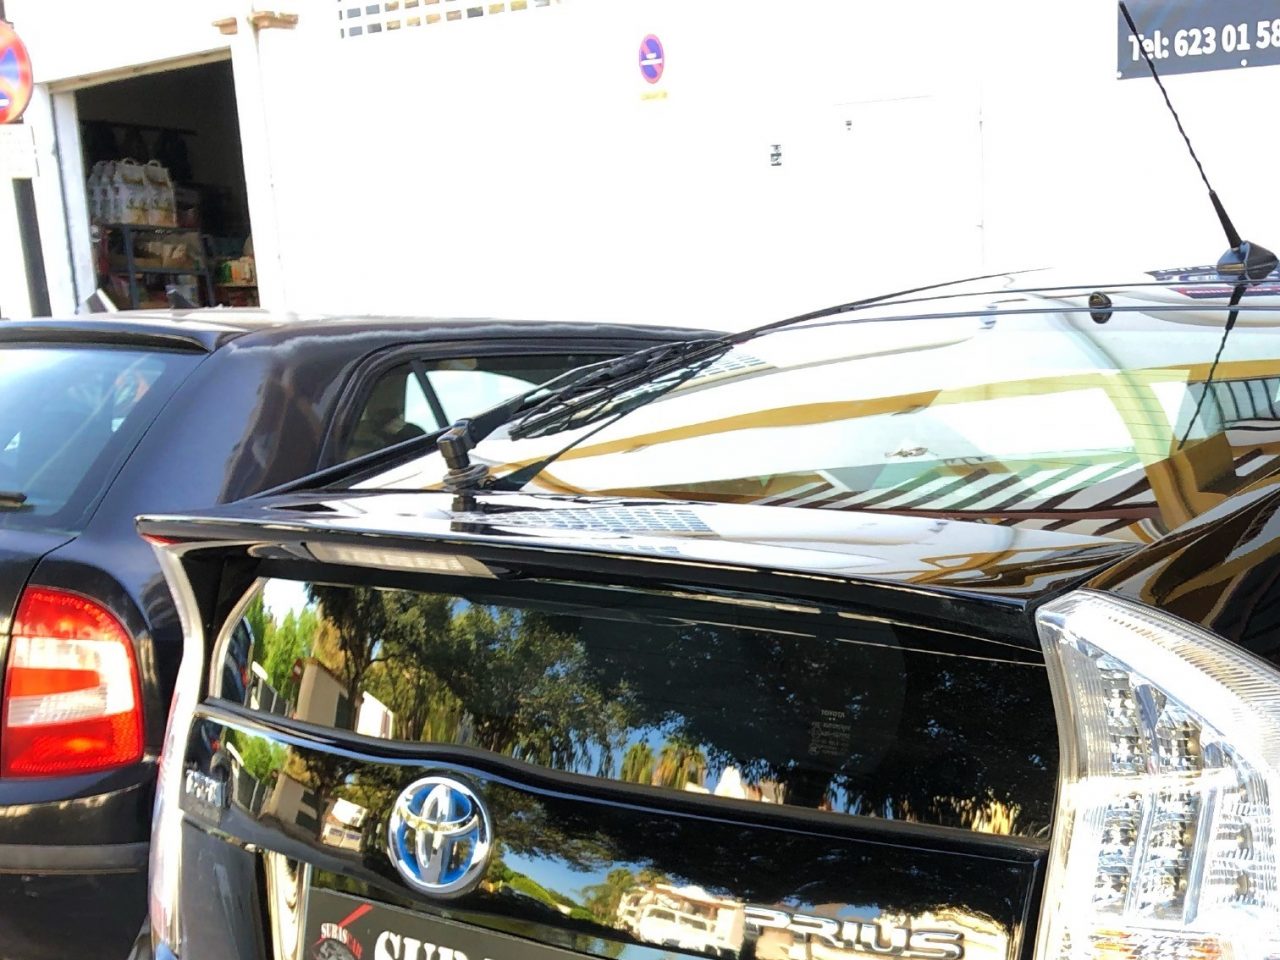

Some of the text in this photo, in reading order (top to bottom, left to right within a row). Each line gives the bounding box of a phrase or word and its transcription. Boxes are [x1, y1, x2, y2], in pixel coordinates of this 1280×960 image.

[1128, 30, 1169, 61] Tel:
[1174, 26, 1216, 57] 623
[1221, 23, 1251, 53] 01
[743, 903, 965, 960] PRIUS
